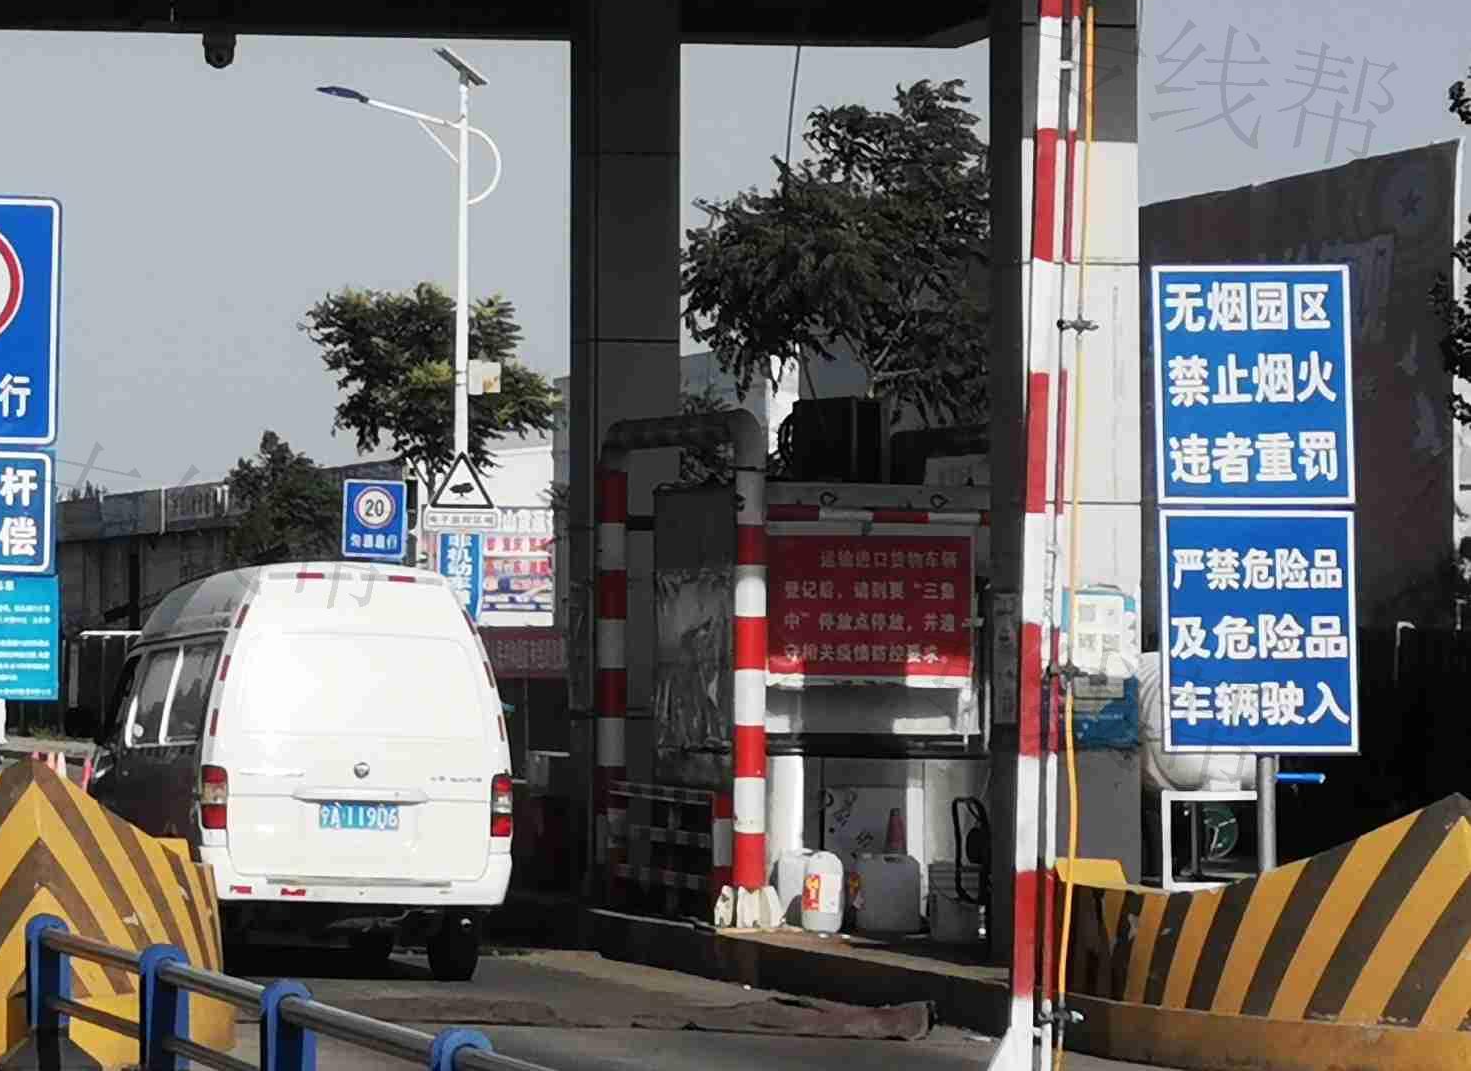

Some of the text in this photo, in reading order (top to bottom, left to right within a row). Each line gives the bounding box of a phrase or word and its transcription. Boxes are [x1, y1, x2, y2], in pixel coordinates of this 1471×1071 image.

[1164, 282, 1331, 333] 无烟园区
[1167, 353, 1337, 408] 禁止烟火
[1169, 431, 1338, 484] 违者重罚
[364, 498, 385, 517] 20
[1172, 548, 1343, 591] 严禁危险品
[1170, 614, 1349, 661] 及危险品
[1170, 680, 1350, 728] 车辆驶入
